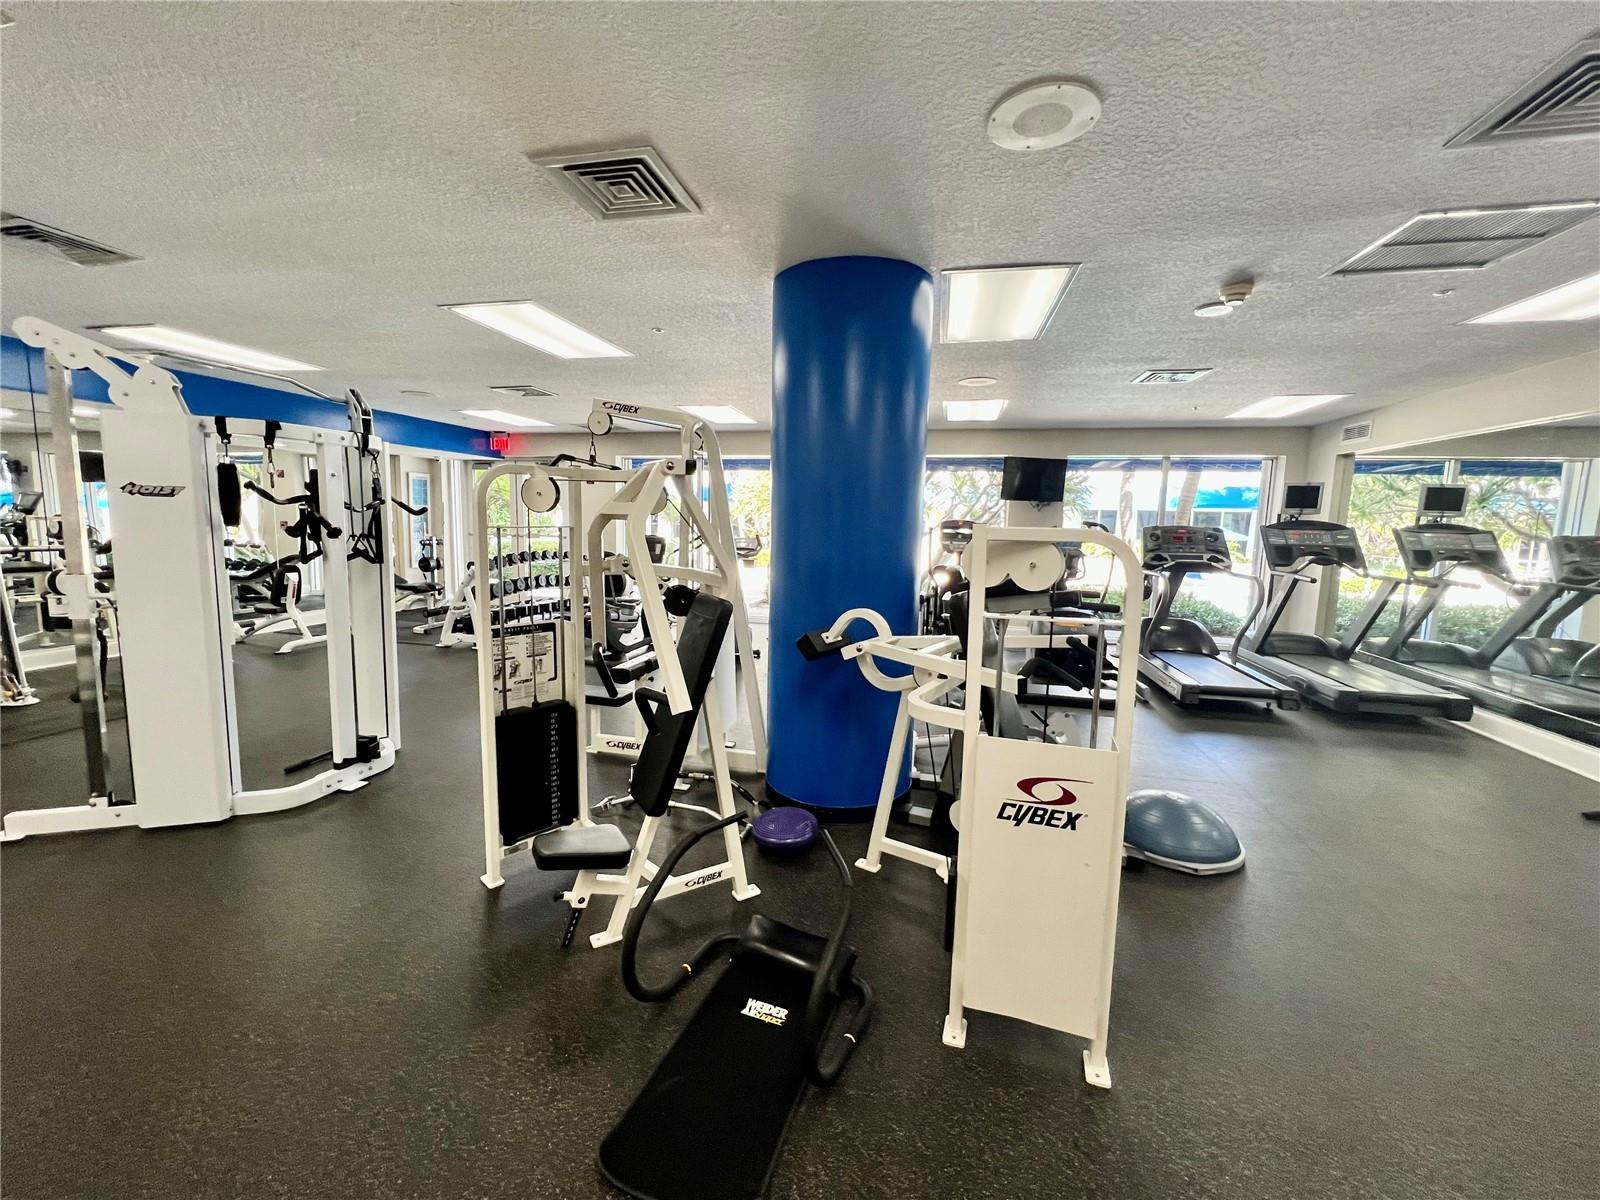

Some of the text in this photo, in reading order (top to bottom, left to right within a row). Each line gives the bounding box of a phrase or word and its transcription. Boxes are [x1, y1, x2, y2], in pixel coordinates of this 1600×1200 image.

[613, 403, 640, 414] CYBEX
[120, 482, 186, 497] HOIST
[616, 741, 641, 751] CYBEX
[996, 802, 1083, 831] CYBEX
[697, 871, 723, 885] CYBEX
[746, 998, 789, 1020] WEIDER
